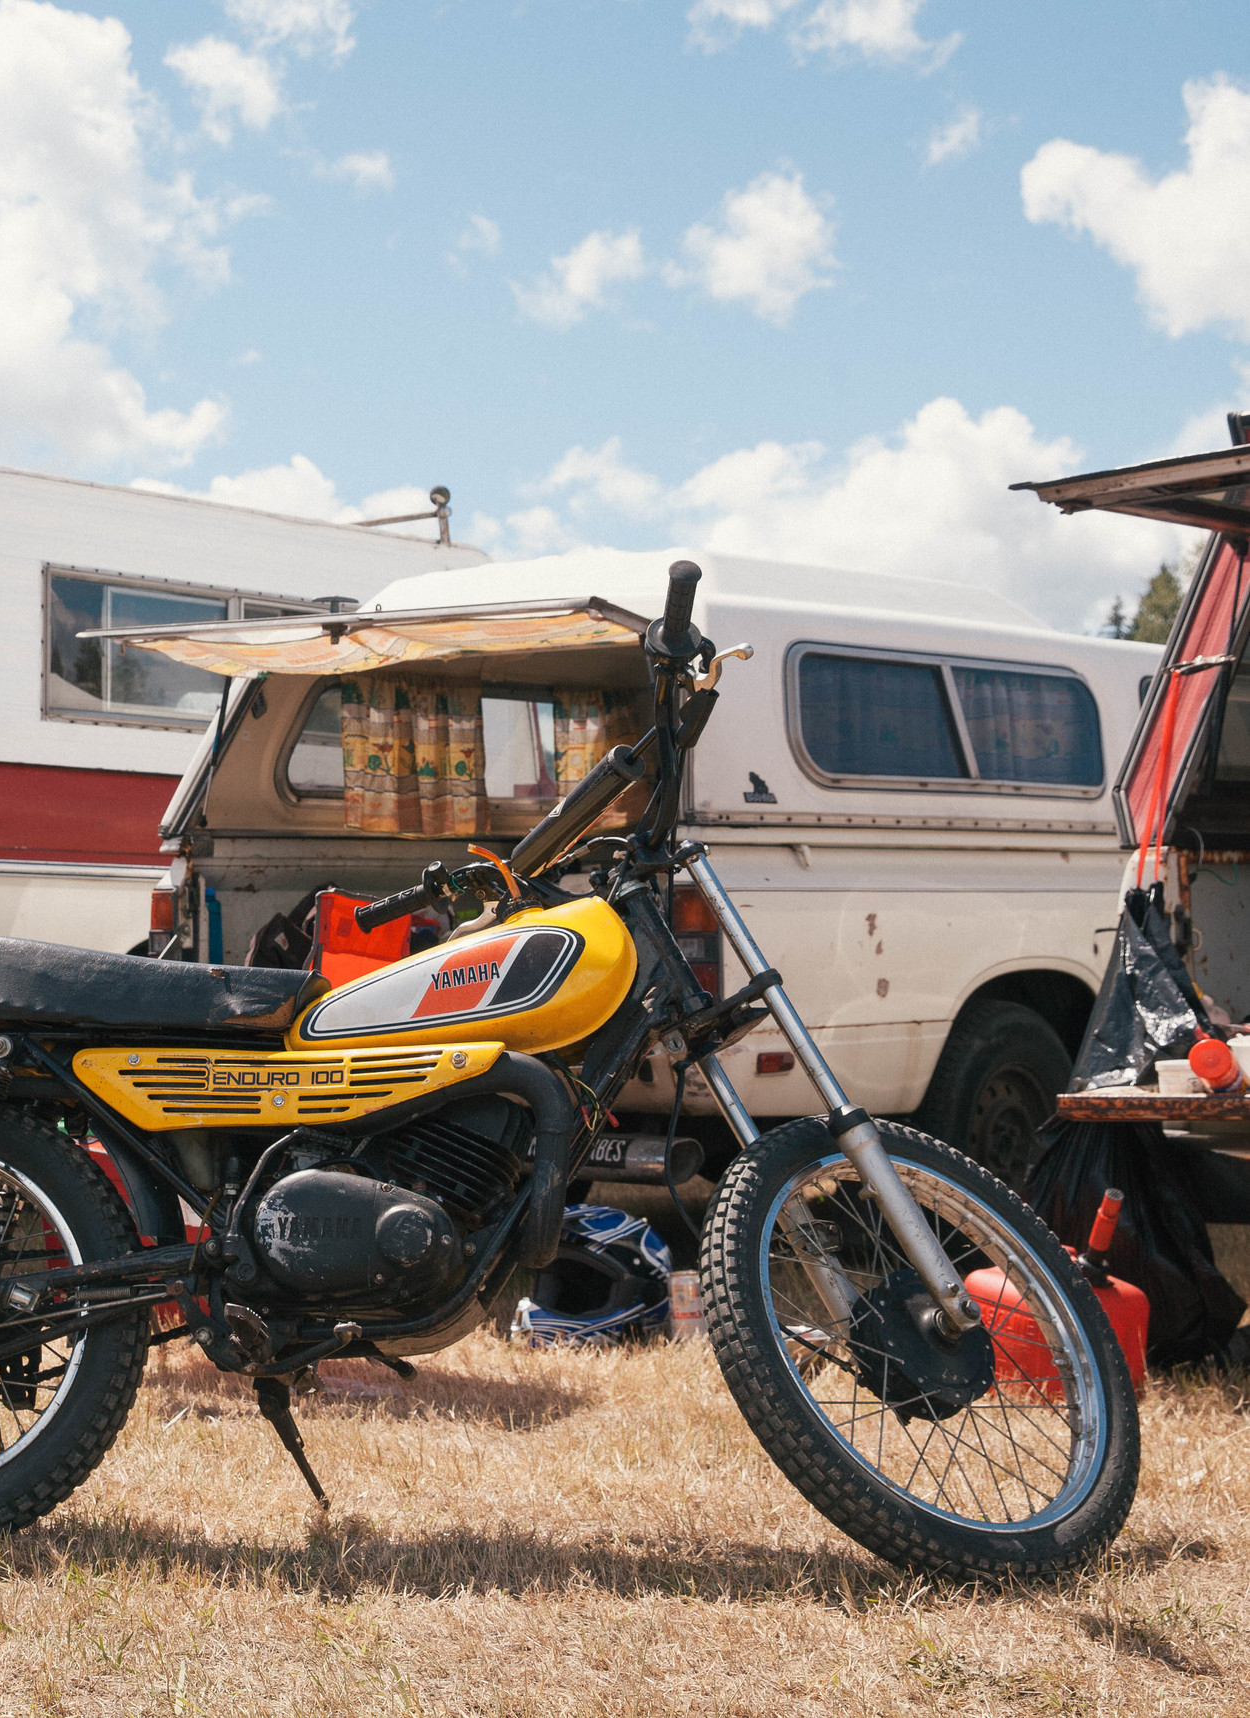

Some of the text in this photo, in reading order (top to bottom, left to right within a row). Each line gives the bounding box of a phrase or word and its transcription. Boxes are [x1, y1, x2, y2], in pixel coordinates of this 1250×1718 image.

[431, 961, 501, 991] YAMAHA
[212, 1070, 344, 1086] ENDURO 100
[276, 1215, 364, 1241] YAMAHA
